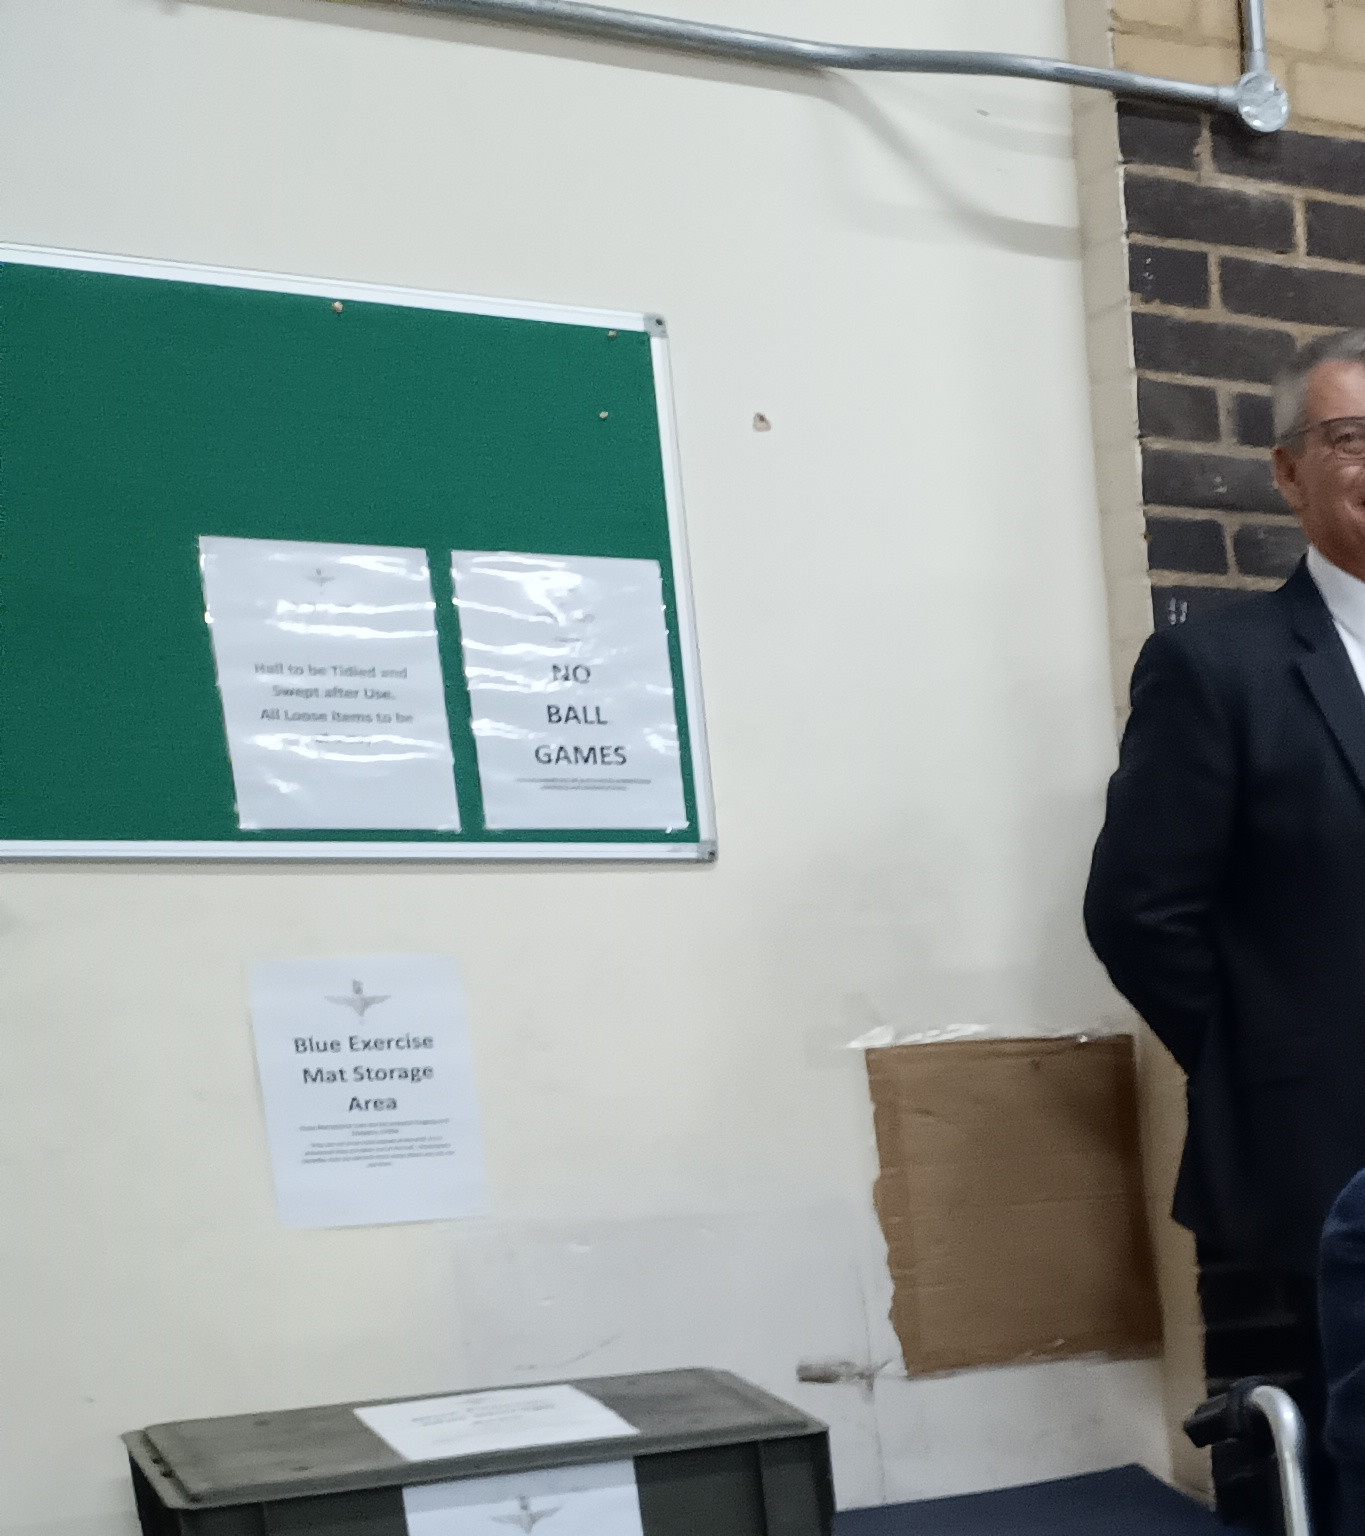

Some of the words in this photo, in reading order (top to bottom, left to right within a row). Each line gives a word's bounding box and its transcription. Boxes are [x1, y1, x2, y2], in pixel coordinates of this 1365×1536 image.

[552, 664, 592, 684] NO
[261, 708, 280, 720] All
[547, 705, 608, 725] BALL
[535, 745, 628, 767] GAMES
[294, 1037, 342, 1054] Blue
[349, 1033, 434, 1053] Exercise
[303, 1067, 348, 1084] Mat
[353, 1065, 435, 1084] Storage
[349, 1097, 398, 1112] Area
